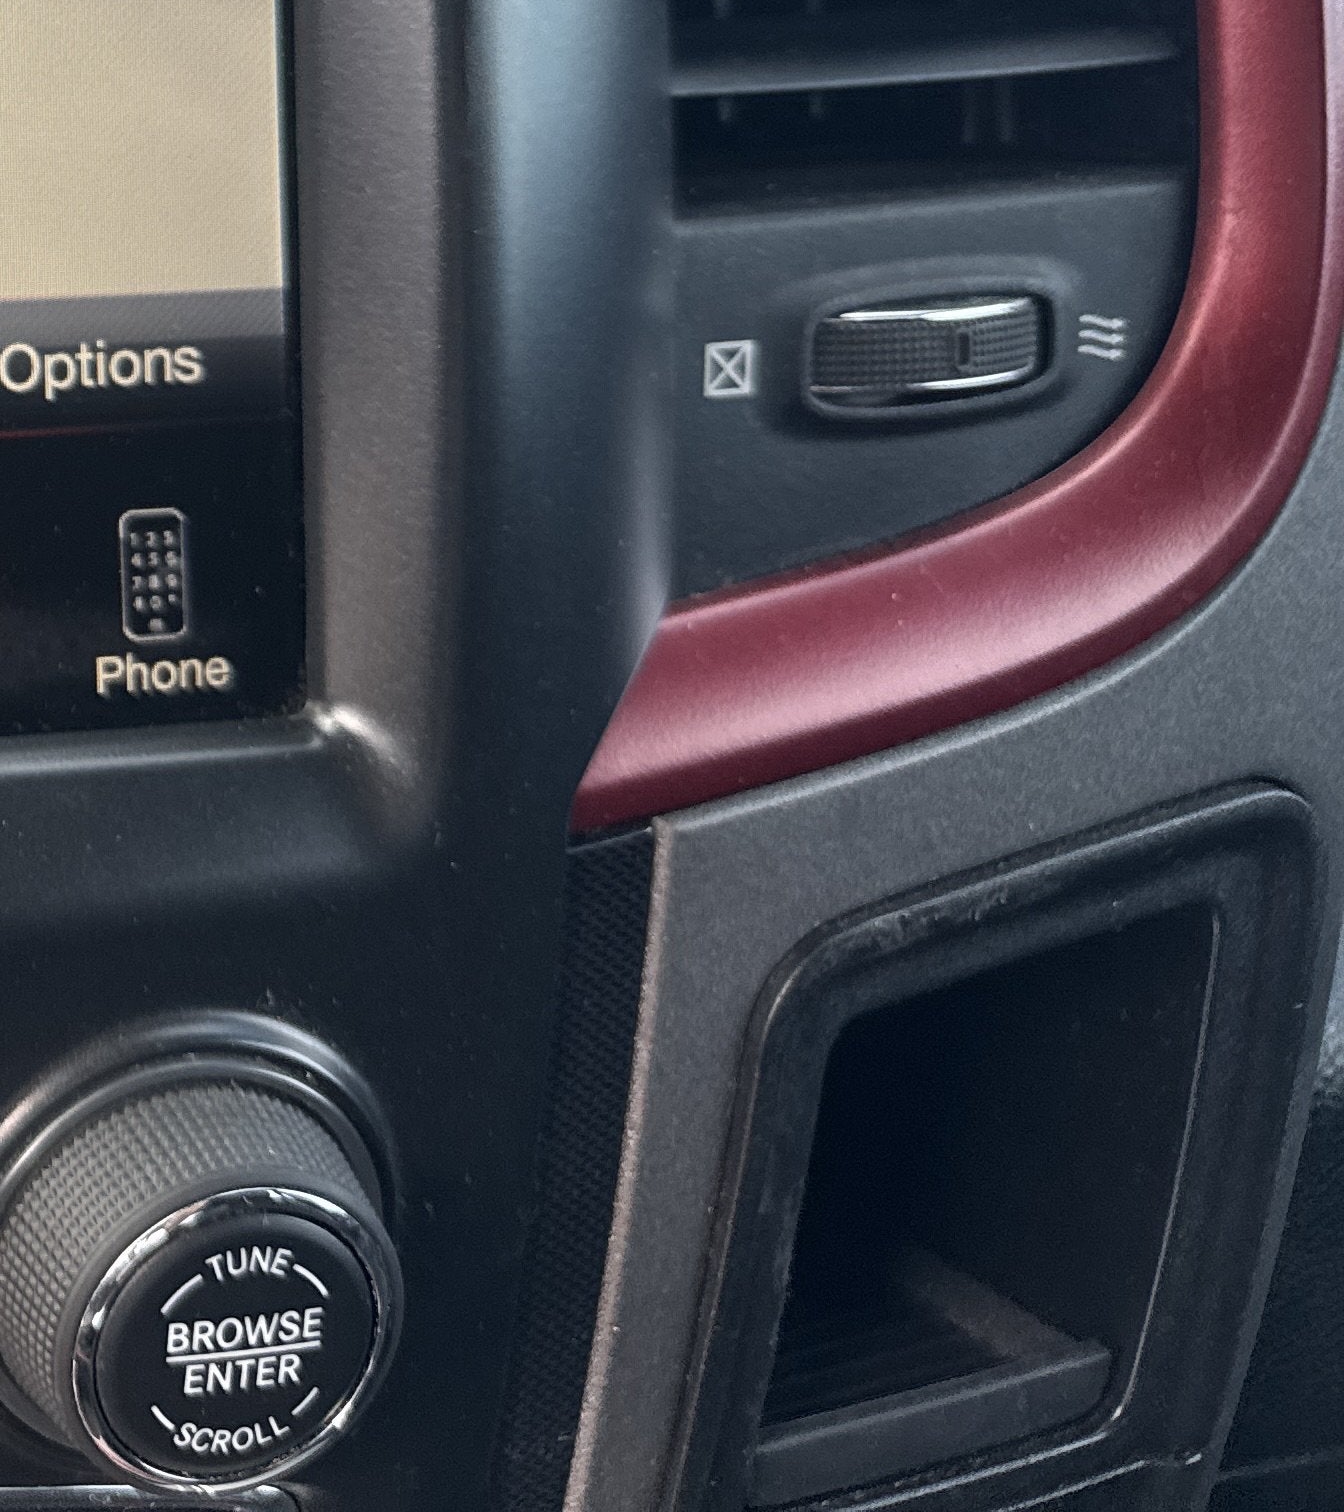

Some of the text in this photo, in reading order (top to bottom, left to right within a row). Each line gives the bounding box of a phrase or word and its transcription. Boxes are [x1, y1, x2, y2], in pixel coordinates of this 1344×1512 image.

[95, 656, 234, 698] Phone
[205, 1246, 292, 1285] TUNE
[167, 1308, 324, 1354] BROWSE
[183, 1354, 302, 1396] ENTER
[173, 1415, 290, 1454] SCROLL
